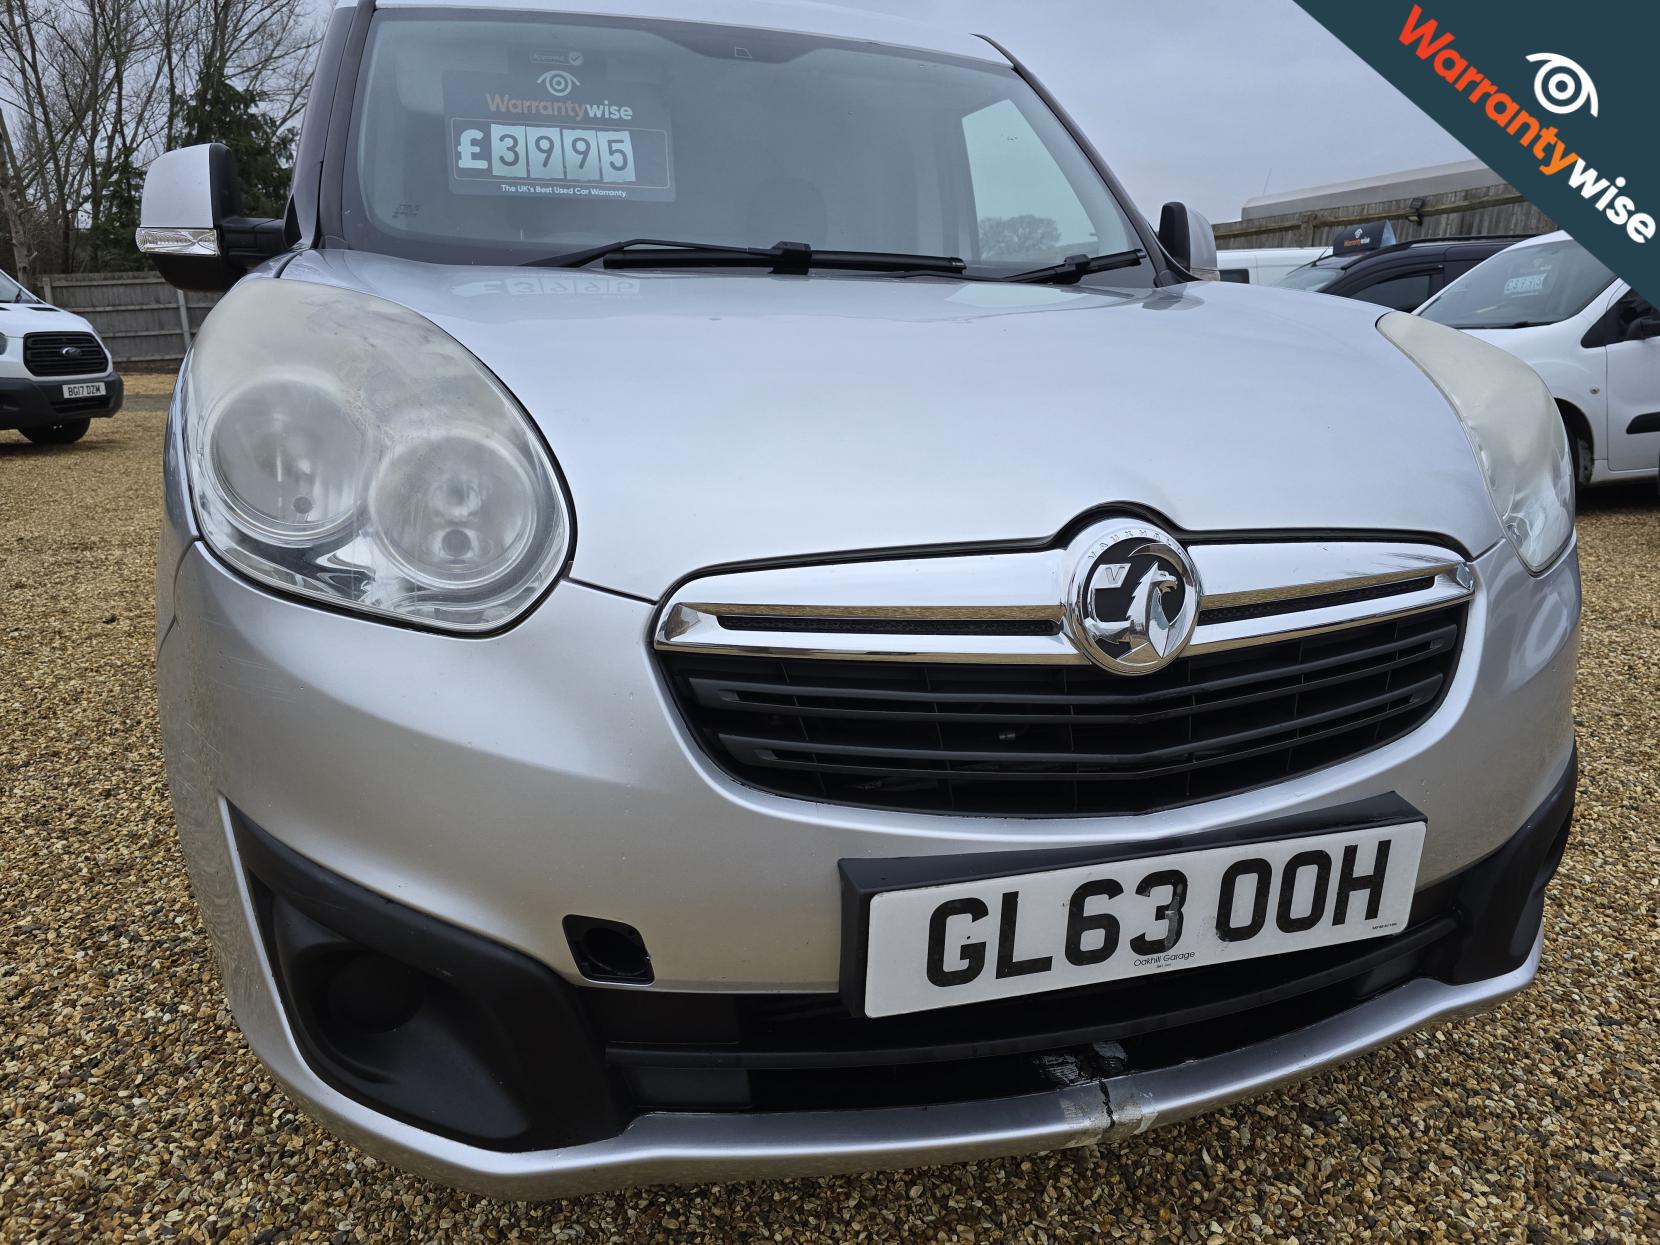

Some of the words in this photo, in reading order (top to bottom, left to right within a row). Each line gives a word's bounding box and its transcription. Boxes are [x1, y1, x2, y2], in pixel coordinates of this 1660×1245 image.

[486, 93, 633, 120] Warrantywise
[457, 128, 629, 173] £3995
[501, 184, 516, 192] The
[517, 185, 535, 193] UK's
[535, 185, 553, 193] Best
[554, 186, 574, 195] Used
[574, 187, 589, 195] Car
[67, 386, 85, 397] BG17
[925, 869, 1189, 988] GL63
[1215, 839, 1393, 943] OOH
[1133, 955, 1162, 967] Oakhill
[1162, 951, 1196, 961] Garage
